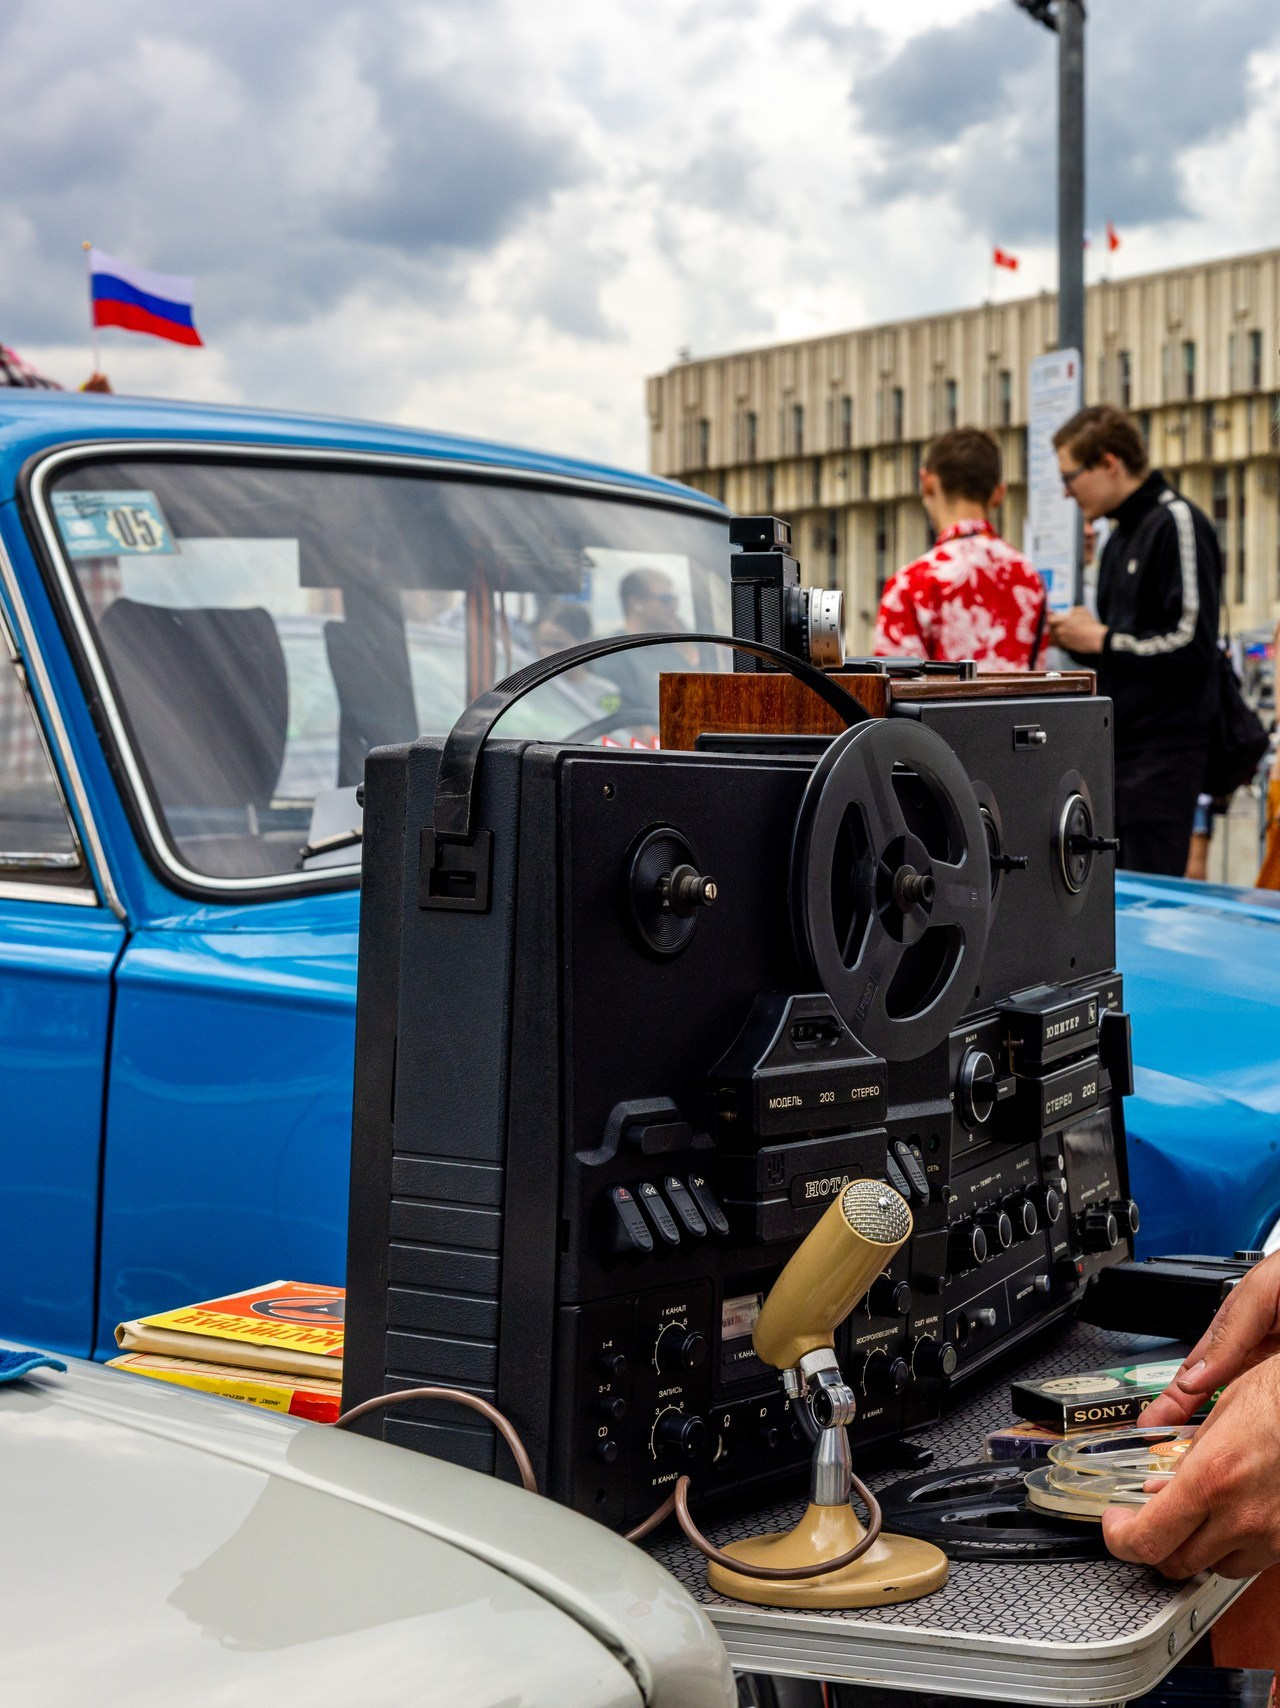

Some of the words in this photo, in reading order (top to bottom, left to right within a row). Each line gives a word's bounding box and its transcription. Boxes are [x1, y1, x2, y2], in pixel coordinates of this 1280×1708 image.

[1046, 1015, 1080, 1039] ЮПИТЕР
[769, 1095, 803, 1110] МОДЕЛЬ
[819, 1090, 836, 1104] 203
[851, 1084, 881, 1099] СТЕРЕО
[1045, 1092, 1073, 1115] СТЕРЕО
[1082, 1081, 1097, 1099] 203
[926, 1164, 940, 1173] СЕТЬ
[665, 1304, 687, 1316] КАНАЛ
[172, 1315, 345, 1347] МАГНИТНАЯ
[658, 1386, 683, 1398] ЗАПИСЬ
[1074, 1403, 1130, 1423] SONY
[658, 1471, 679, 1484] КАНАЛ
